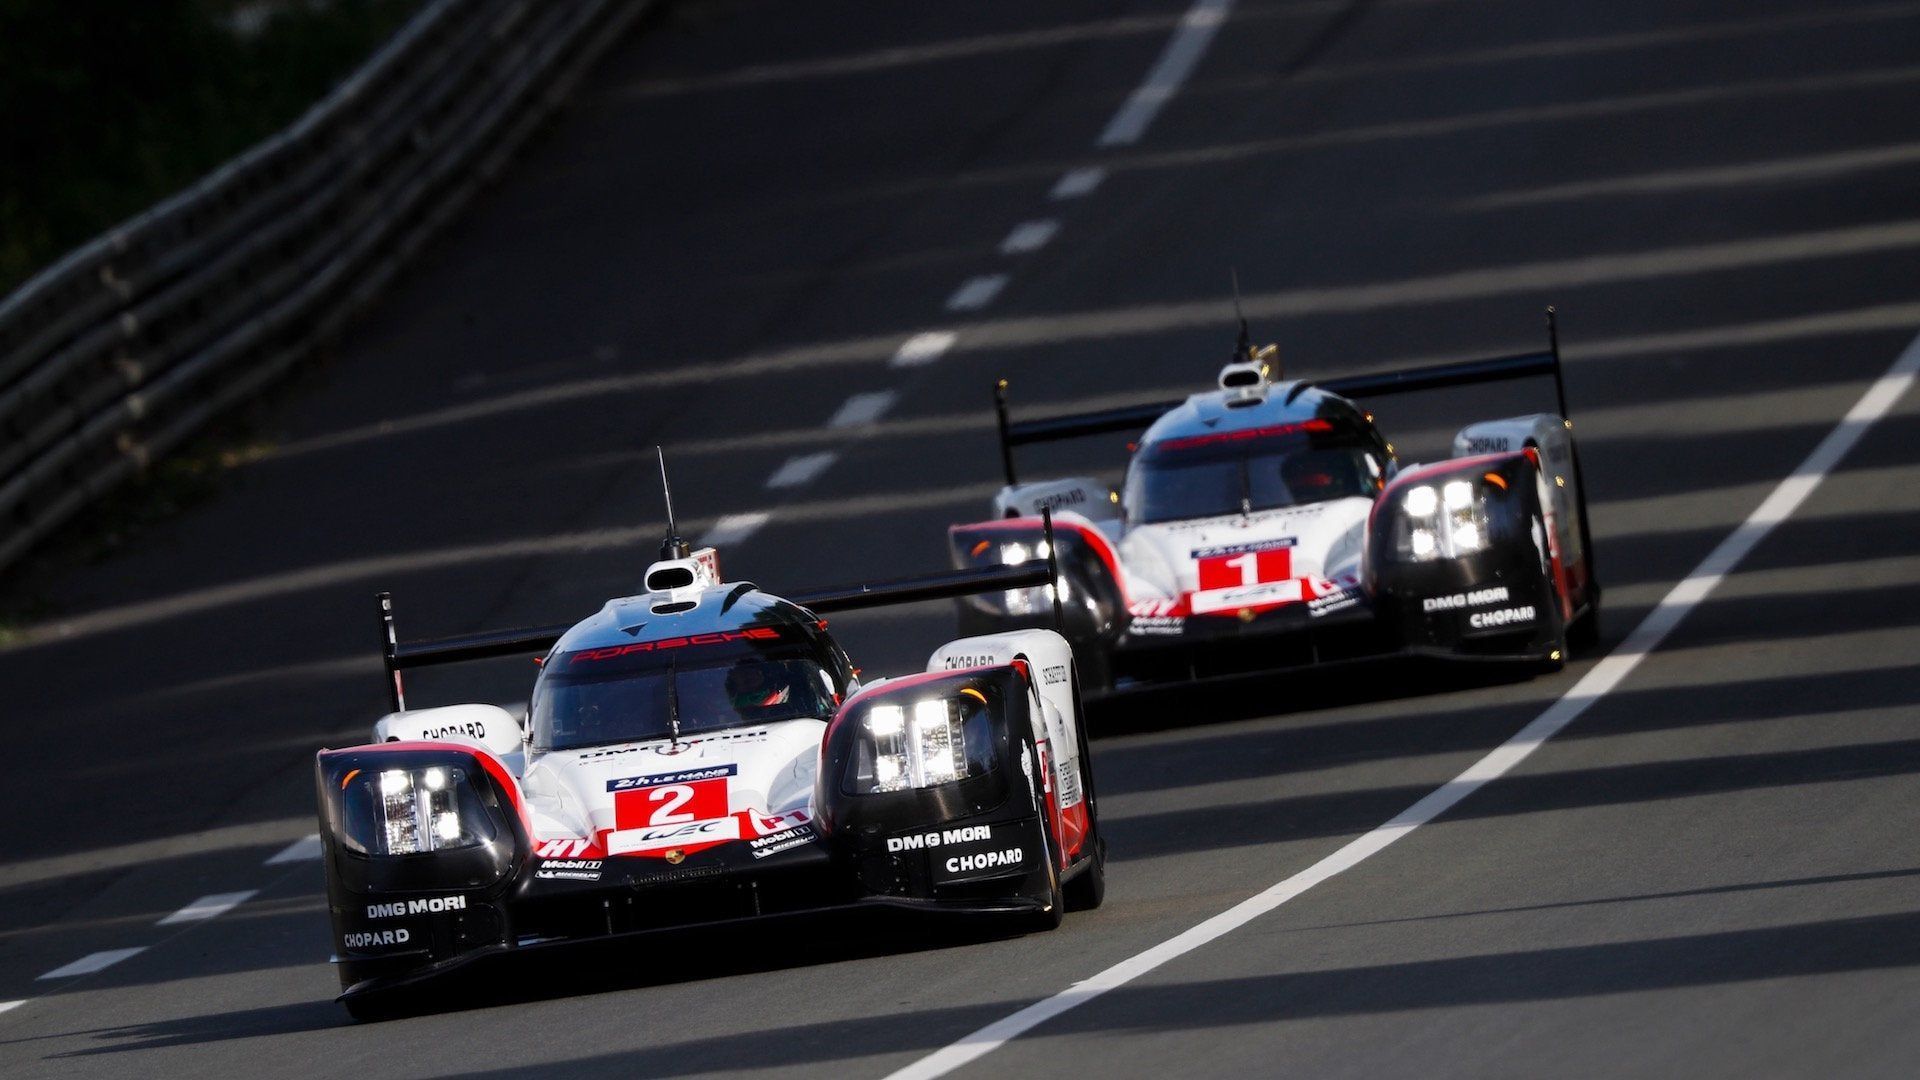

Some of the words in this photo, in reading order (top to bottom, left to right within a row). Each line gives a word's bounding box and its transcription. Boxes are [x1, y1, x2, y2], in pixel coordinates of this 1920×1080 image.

[1225, 552, 1259, 585] 1
[1423, 593, 1467, 612] DMG
[1467, 586, 1509, 606] MORI
[1470, 605, 1536, 628] CHOPARD
[569, 627, 780, 665] PORSCHE
[653, 774, 676, 784] LE
[677, 767, 730, 781] MANS
[648, 784, 695, 826] 2
[760, 810, 809, 830] P1
[641, 821, 722, 841] WEC
[750, 829, 796, 849] Mobil
[887, 833, 941, 852] DMG
[943, 824, 992, 845] MORI
[536, 838, 590, 858] HY
[541, 860, 586, 869] Mobil
[945, 848, 1023, 873] CHOPARD
[555, 871, 599, 879] MICHELIN
[367, 902, 406, 919] DMG
[409, 895, 467, 914] MORI
[344, 929, 410, 948] CHOPARD
